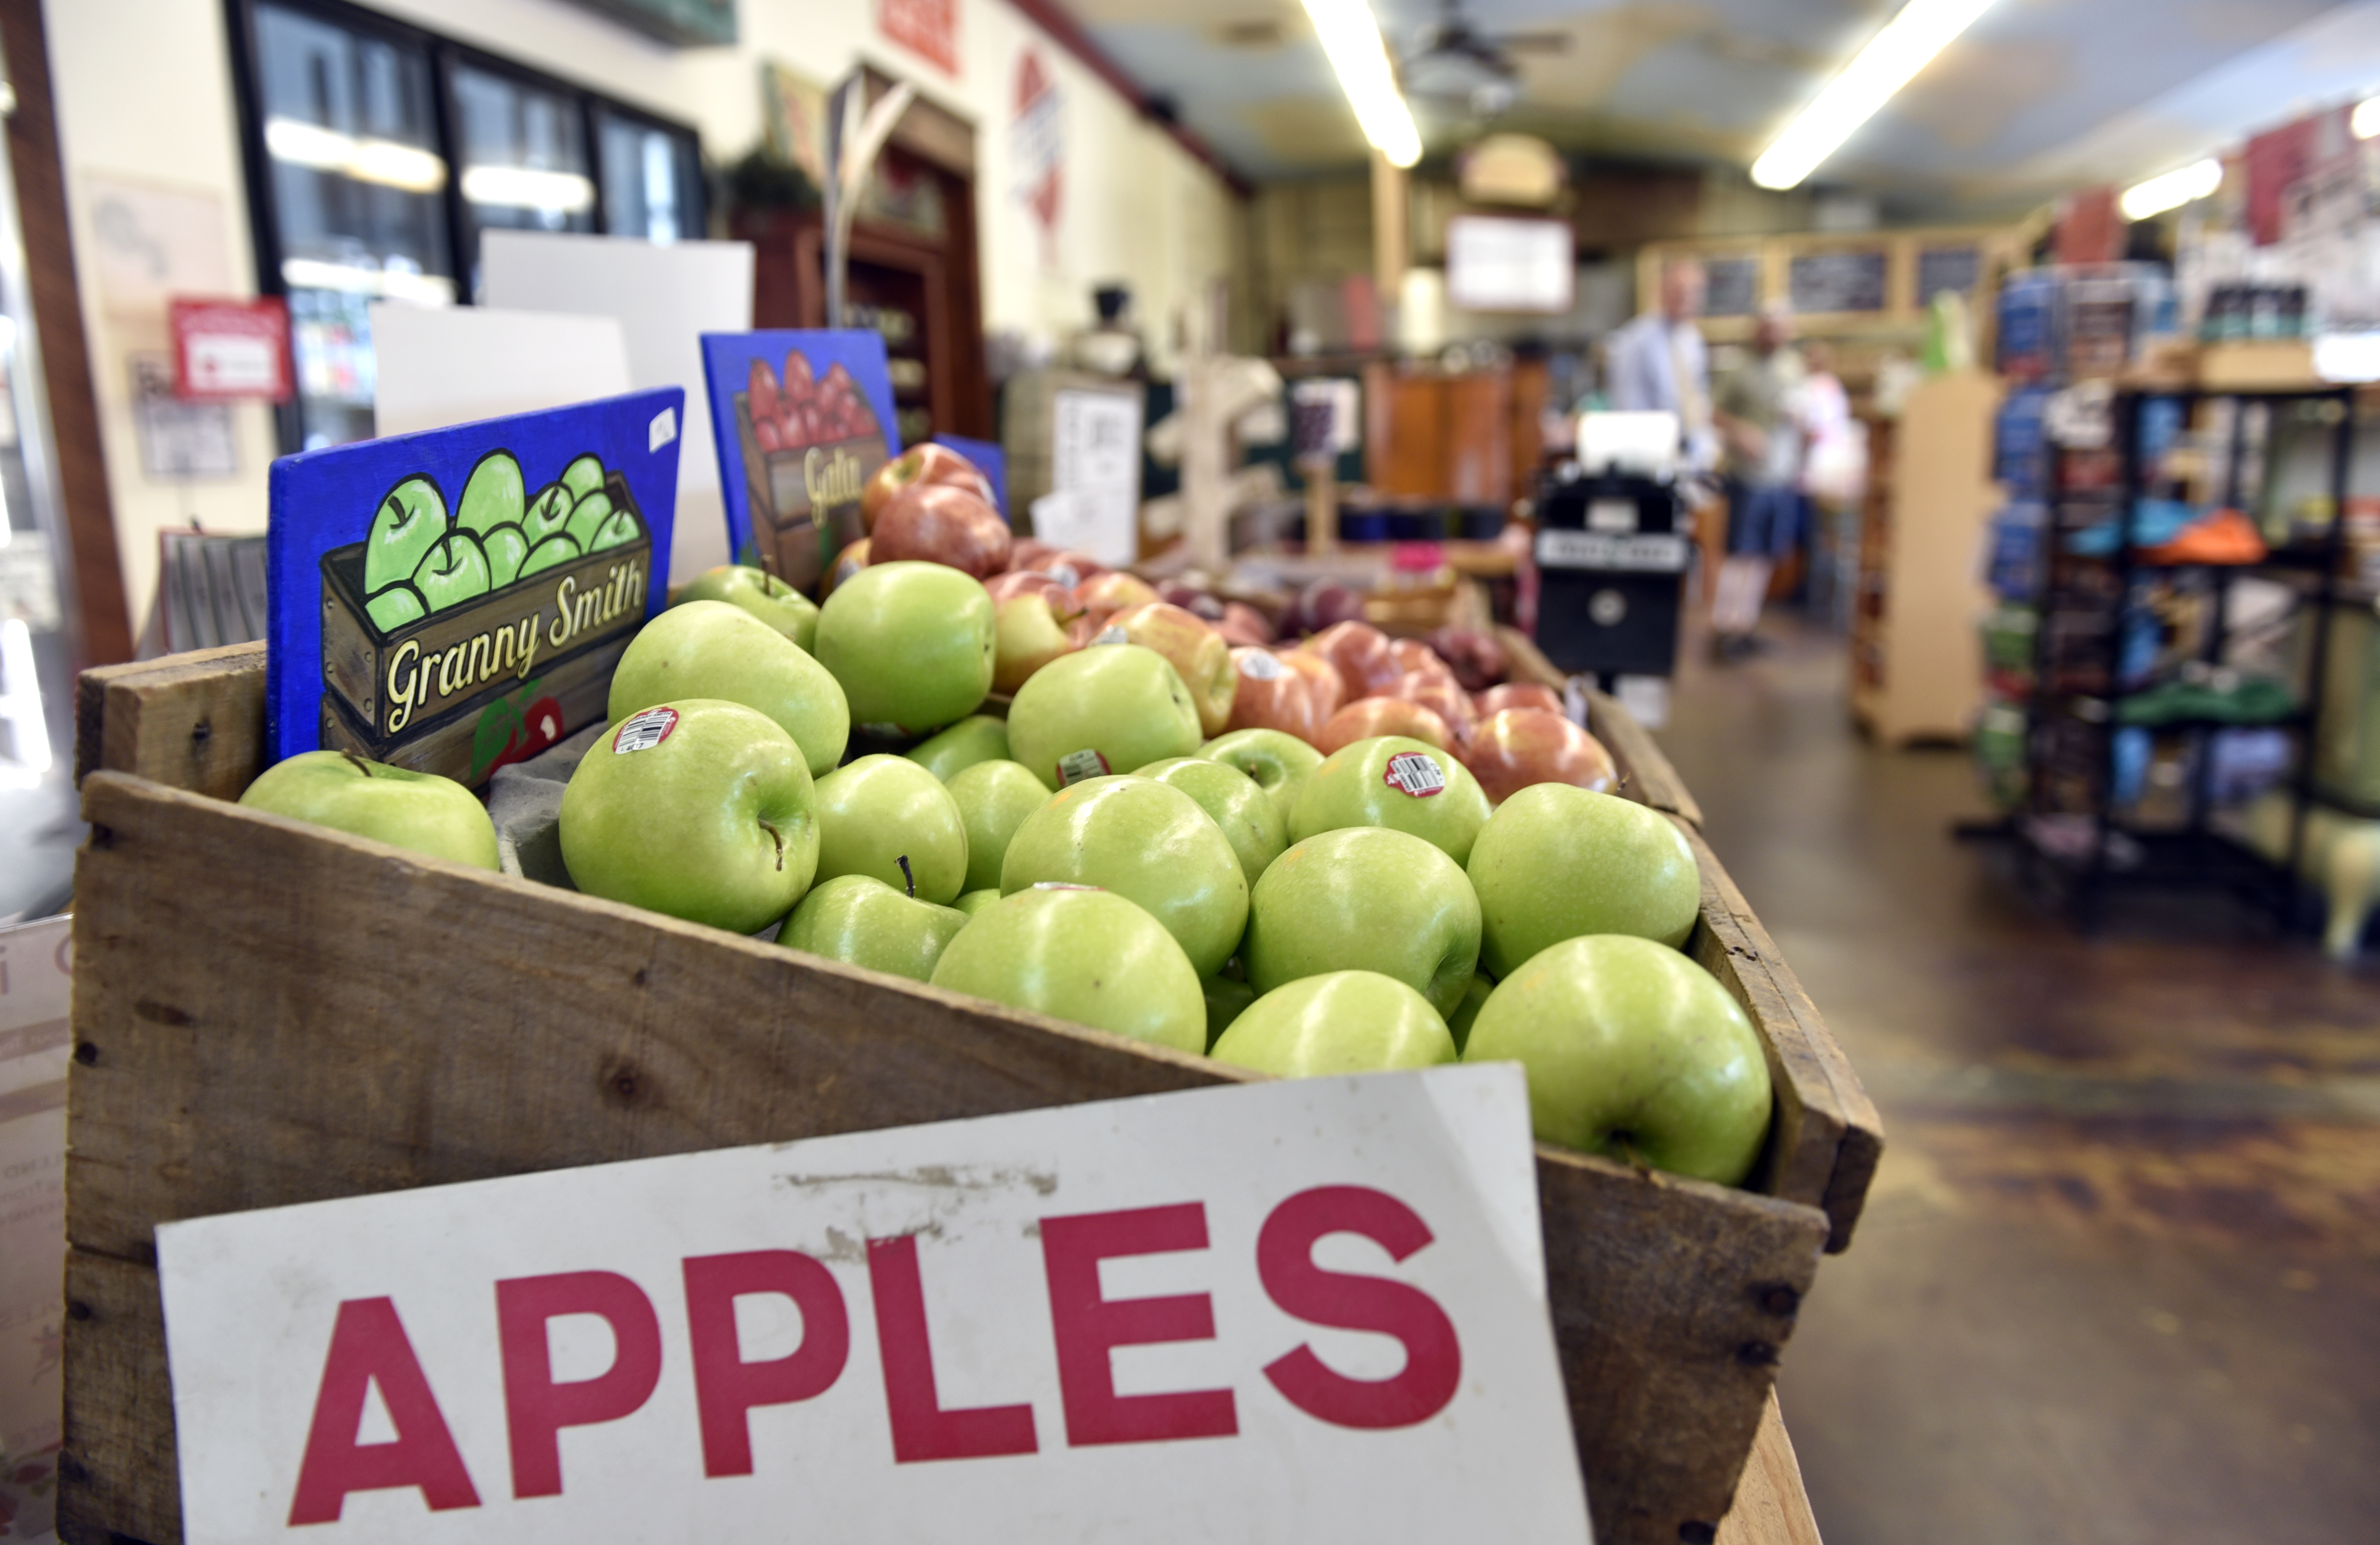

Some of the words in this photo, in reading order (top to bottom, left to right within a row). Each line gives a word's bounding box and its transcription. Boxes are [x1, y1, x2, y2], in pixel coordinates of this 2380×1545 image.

[805, 446, 863, 529] Gala
[387, 613, 541, 733] Granny
[549, 558, 644, 648] Smith
[286, 1184, 1462, 1528] APPLES
